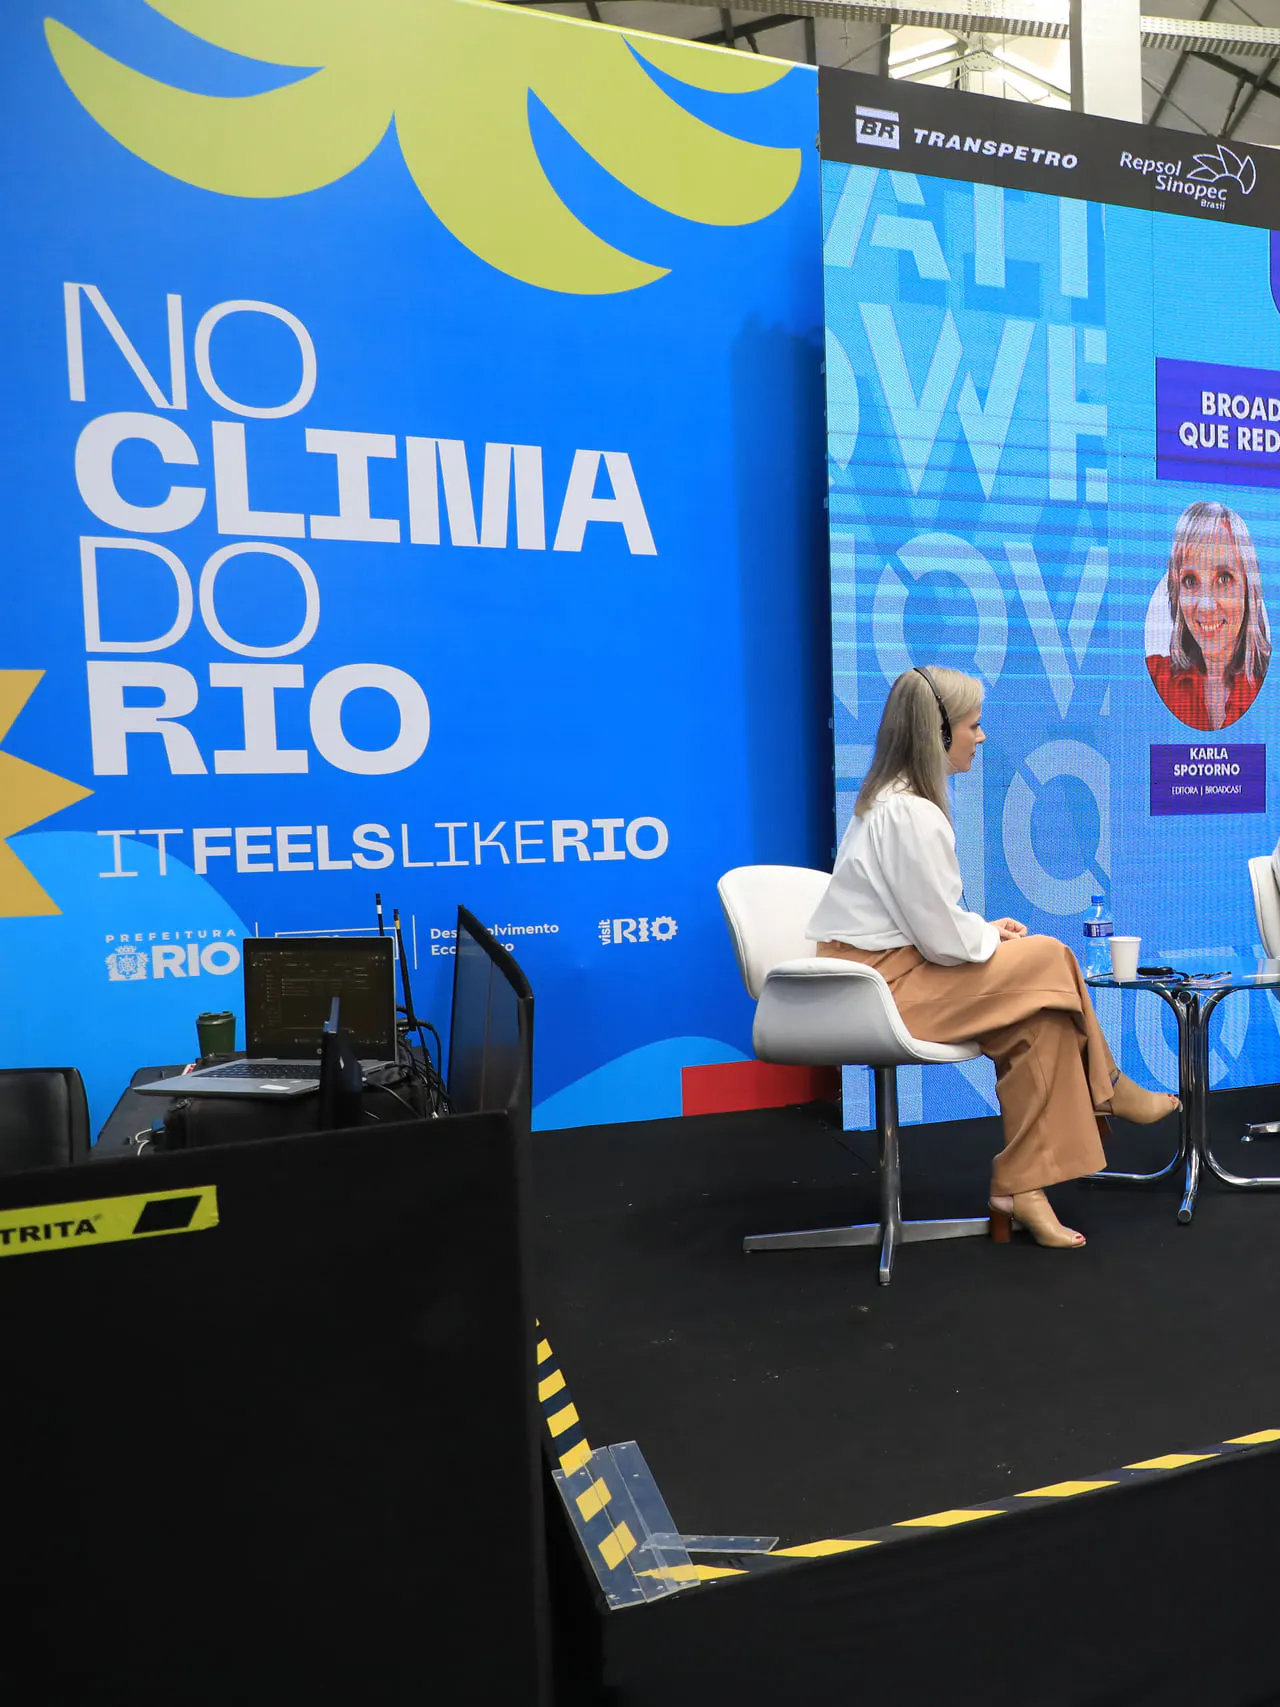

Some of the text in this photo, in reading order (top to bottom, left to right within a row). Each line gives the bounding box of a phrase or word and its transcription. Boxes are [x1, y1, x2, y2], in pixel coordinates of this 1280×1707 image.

[913, 127, 1079, 170] TRANSPETRO
[1120, 151, 1181, 177] Repsol
[1155, 174, 1228, 201] Sinopec
[1200, 199, 1225, 211] Brasil
[63, 281, 317, 419] NO
[1179, 421, 1229, 449] QUE
[74, 411, 658, 556] CLIMA
[79, 535, 320, 658] DO
[86, 660, 430, 775] RIO
[1190, 747, 1229, 760] KARLA
[1173, 763, 1240, 777] SPOTORNO
[1172, 786, 1198, 796] EDITORA
[1205, 785, 1242, 795] BROADCAST
[105, 929, 237, 943] PREFEITURA
[613, 915, 679, 945] RIO
[151, 942, 241, 979] RIO
